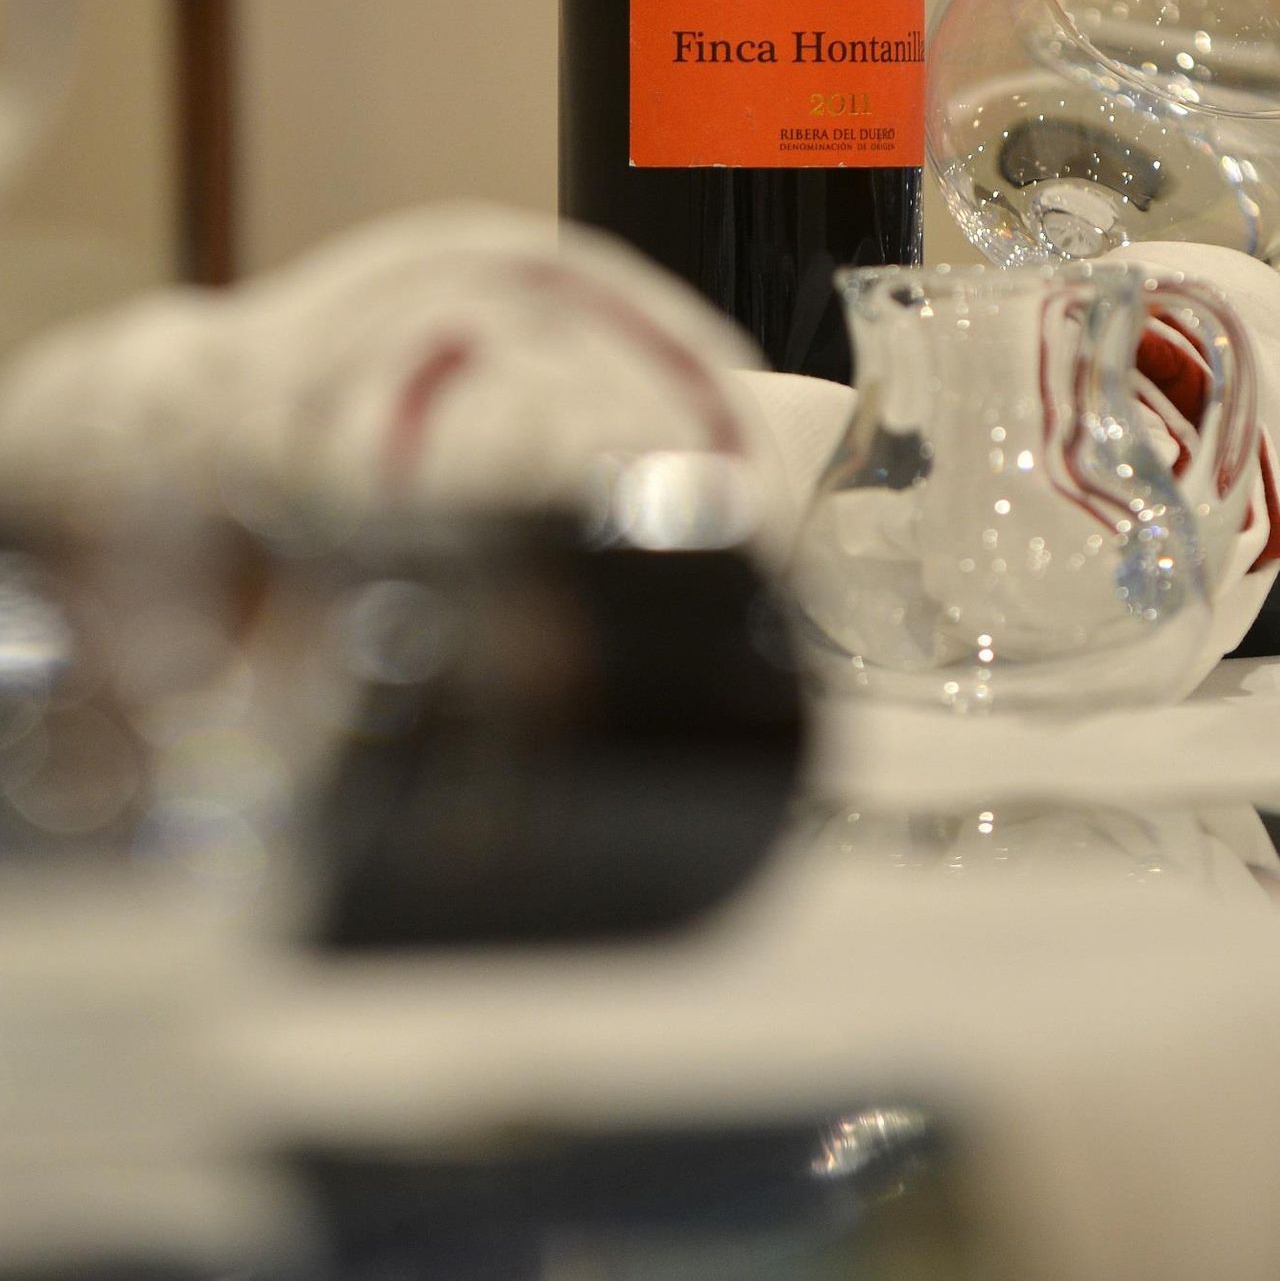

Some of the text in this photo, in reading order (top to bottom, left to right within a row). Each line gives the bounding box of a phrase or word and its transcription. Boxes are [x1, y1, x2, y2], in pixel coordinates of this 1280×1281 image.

[672, 31, 778, 63] Finca
[810, 93, 872, 116] 2011
[780, 128, 895, 140] RIBERA DEL DUERO
[857, 143, 867, 151] DE
